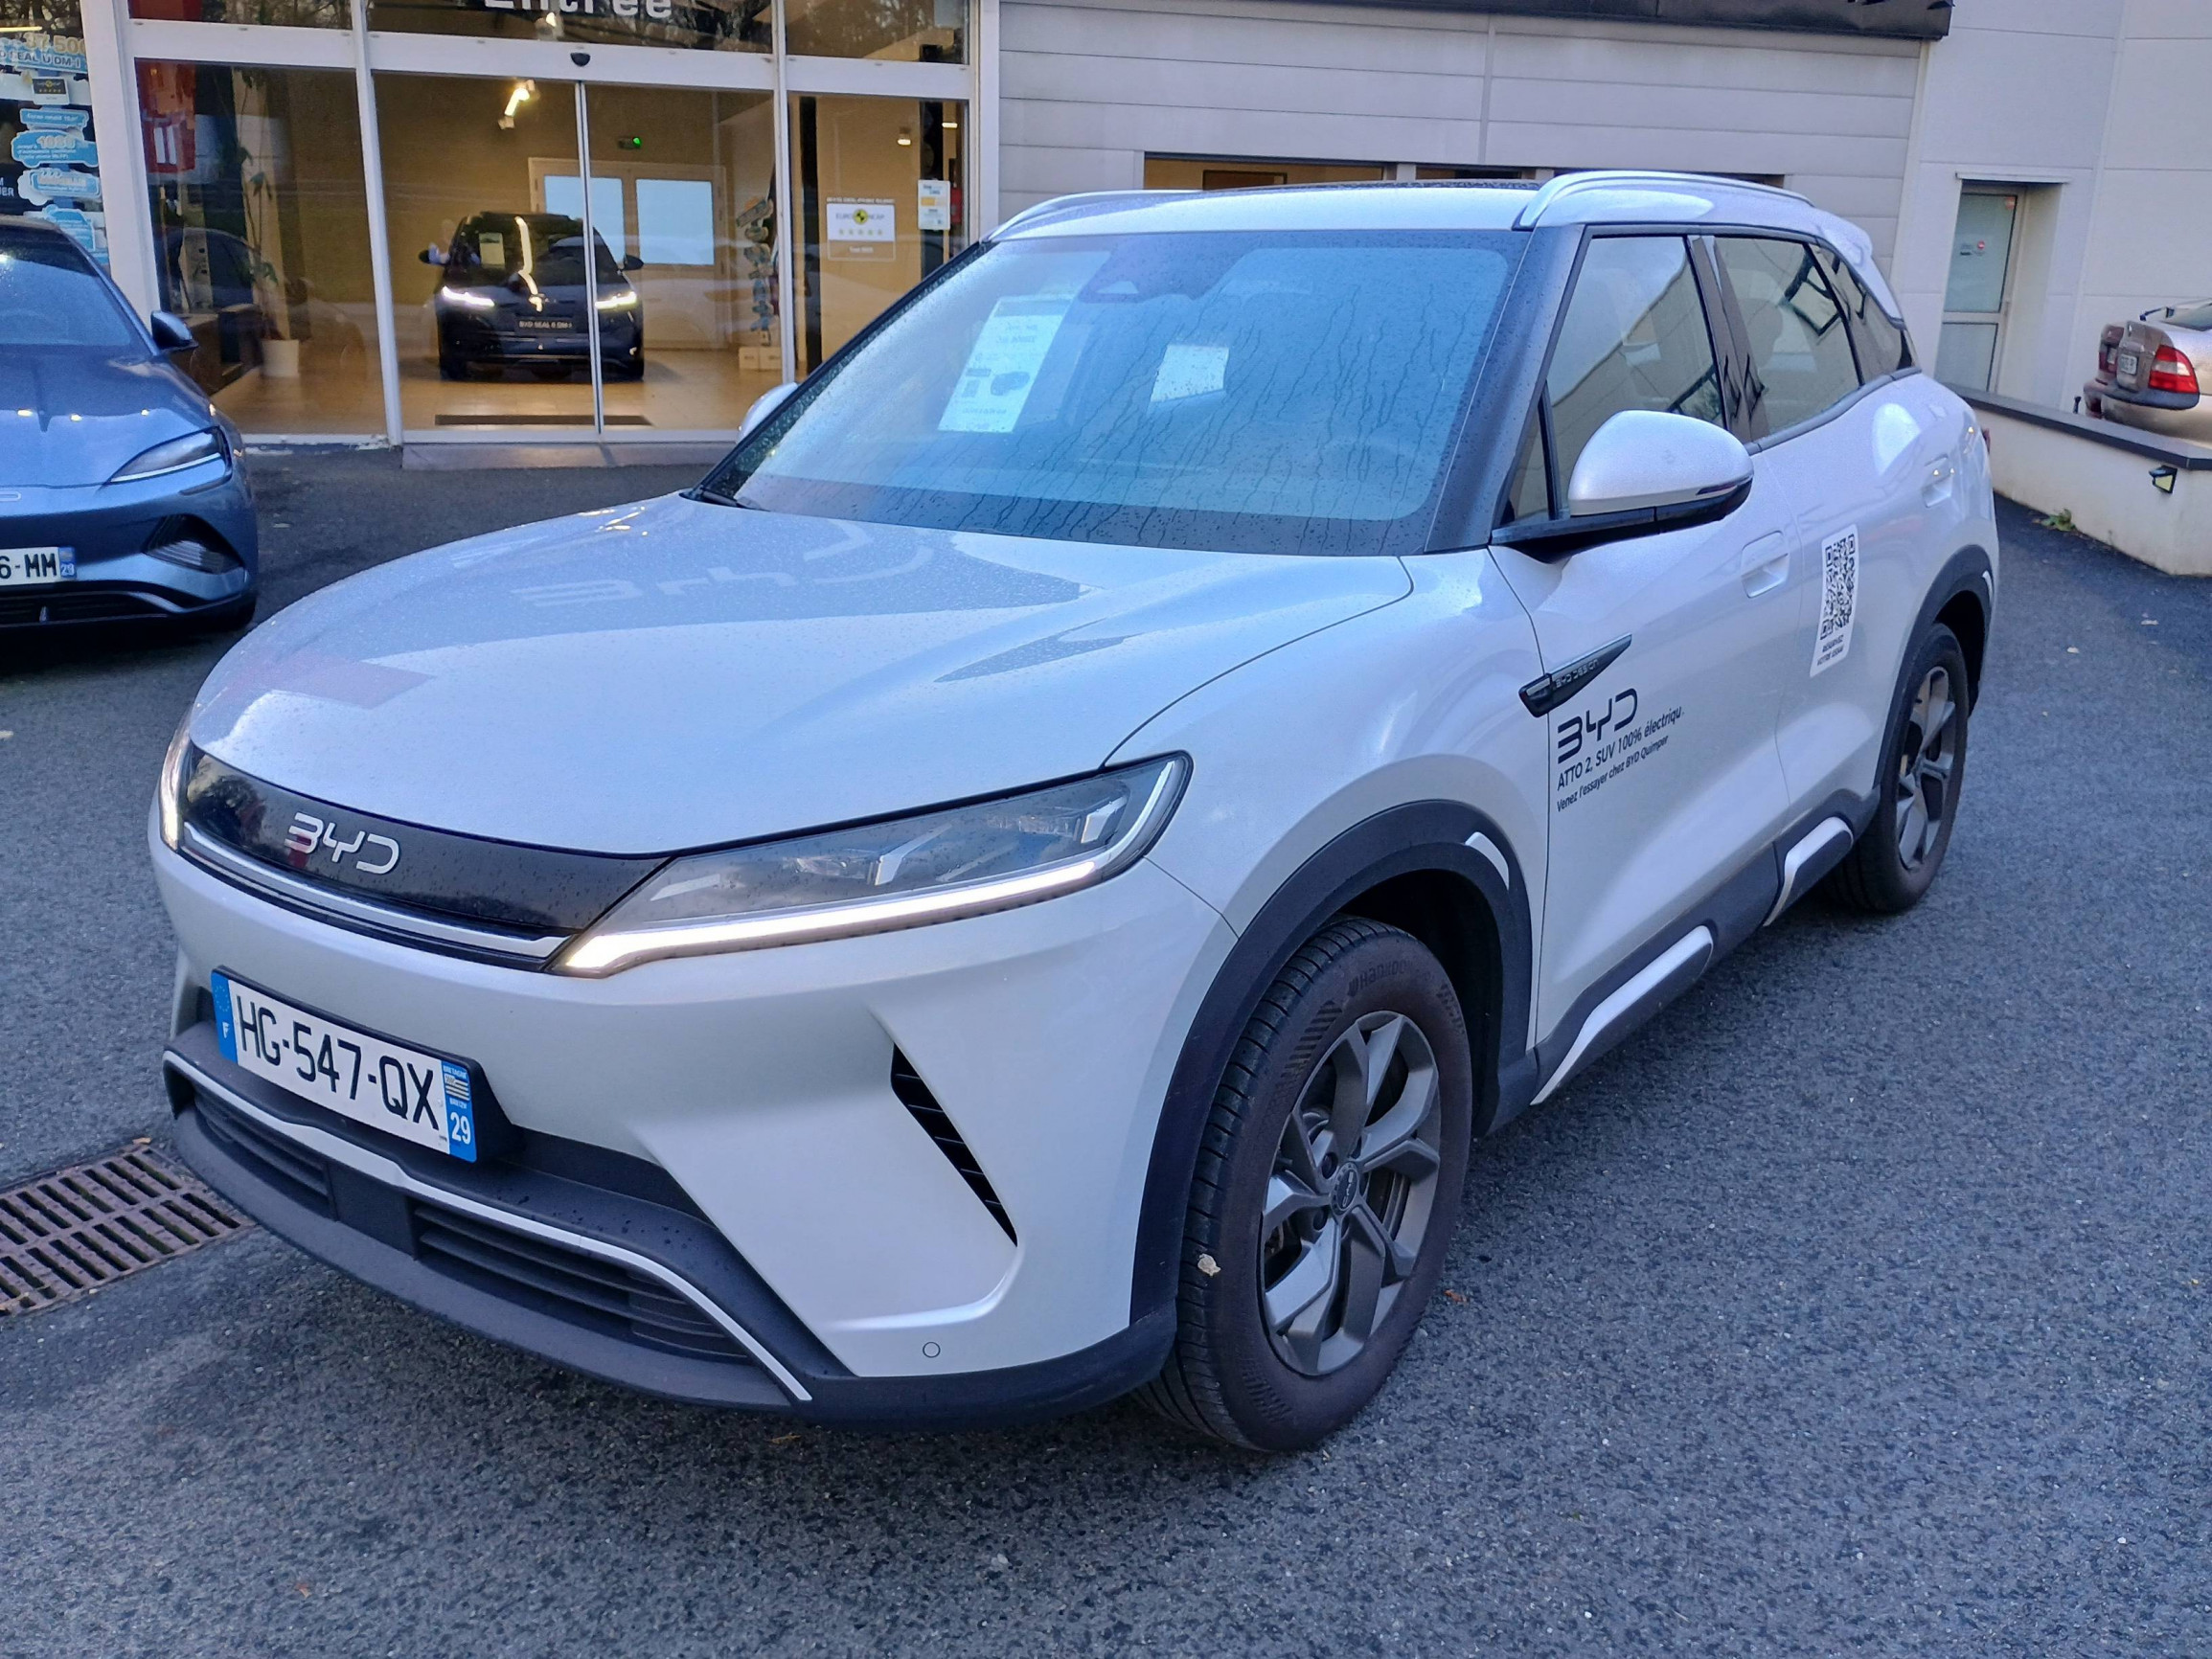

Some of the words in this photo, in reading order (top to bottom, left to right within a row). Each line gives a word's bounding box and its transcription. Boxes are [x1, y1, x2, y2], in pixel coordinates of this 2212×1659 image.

[1557, 688, 1638, 764] BYD
[1557, 761, 1583, 791] ATTO
[1595, 741, 1616, 767] SUV
[1618, 728, 1642, 755] 100%
[1644, 706, 1684, 739] électriqu
[1557, 790, 1578, 812] Venez
[1579, 773, 1608, 799] l'essayer
[1608, 762, 1625, 779] chez
[1626, 751, 1640, 769] BYD
[1640, 735, 1669, 760] Quimper
[285, 811, 399, 875] BYD
[236, 995, 440, 1131] HG-547-QX
[450, 1111, 471, 1145] 29
